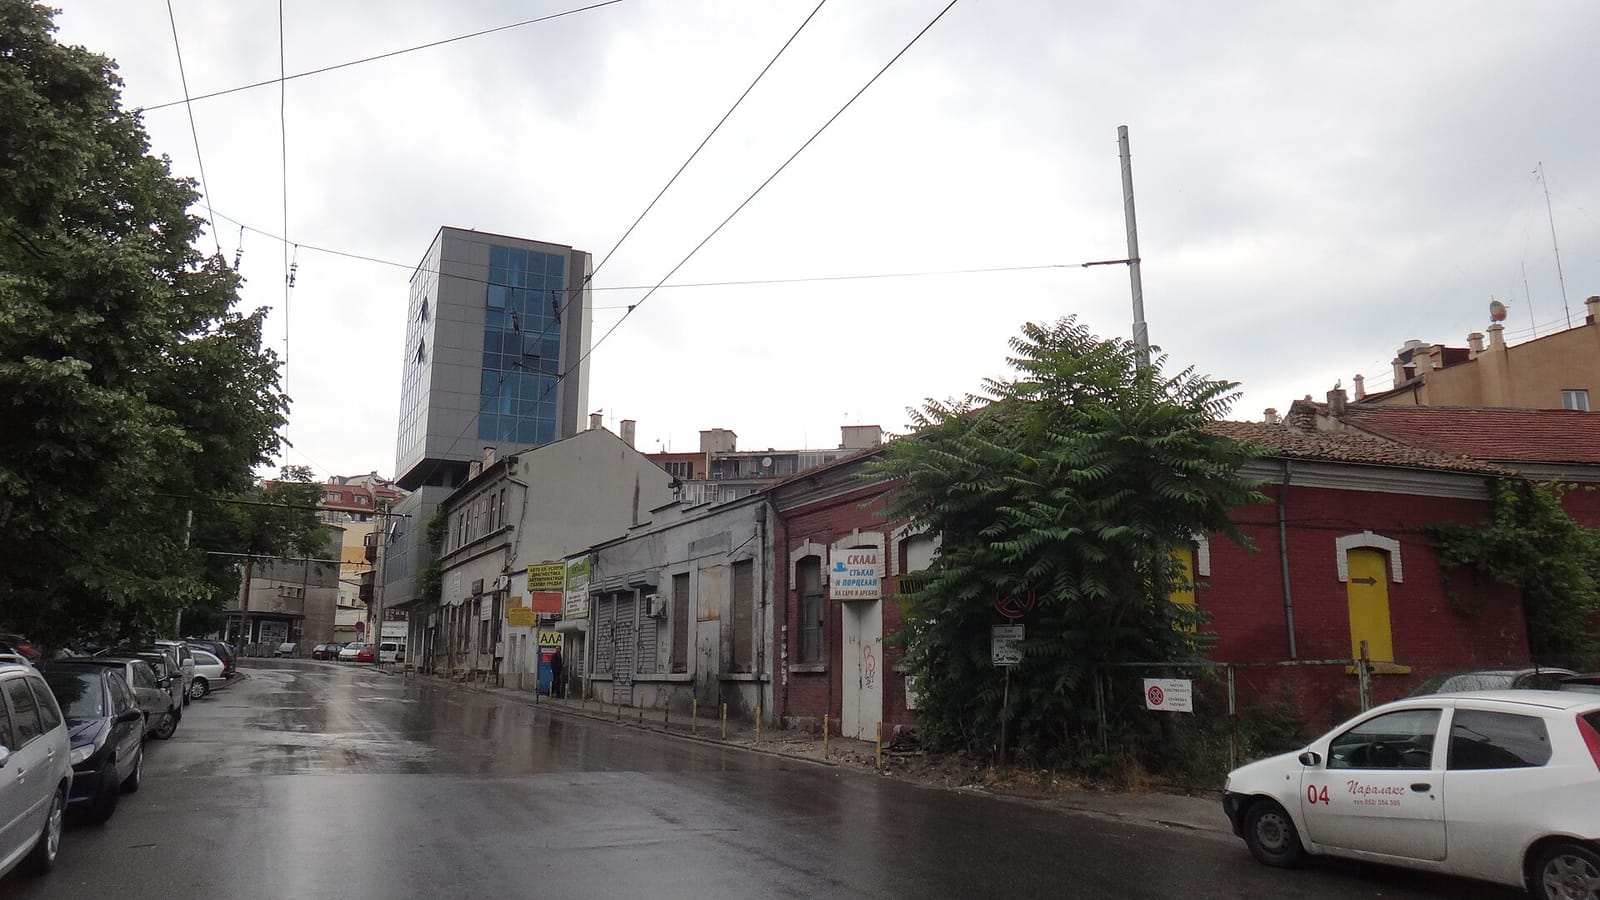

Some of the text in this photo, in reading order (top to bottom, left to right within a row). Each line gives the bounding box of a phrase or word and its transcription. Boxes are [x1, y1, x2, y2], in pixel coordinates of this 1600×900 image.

[847, 554, 877, 565] СКЛАД
[849, 569, 874, 577] СТЪКЛО
[842, 578, 877, 587] ПОРЦЕЛАН
[1347, 780, 1405, 797] Паралакс
[1307, 784, 1330, 805] 04
